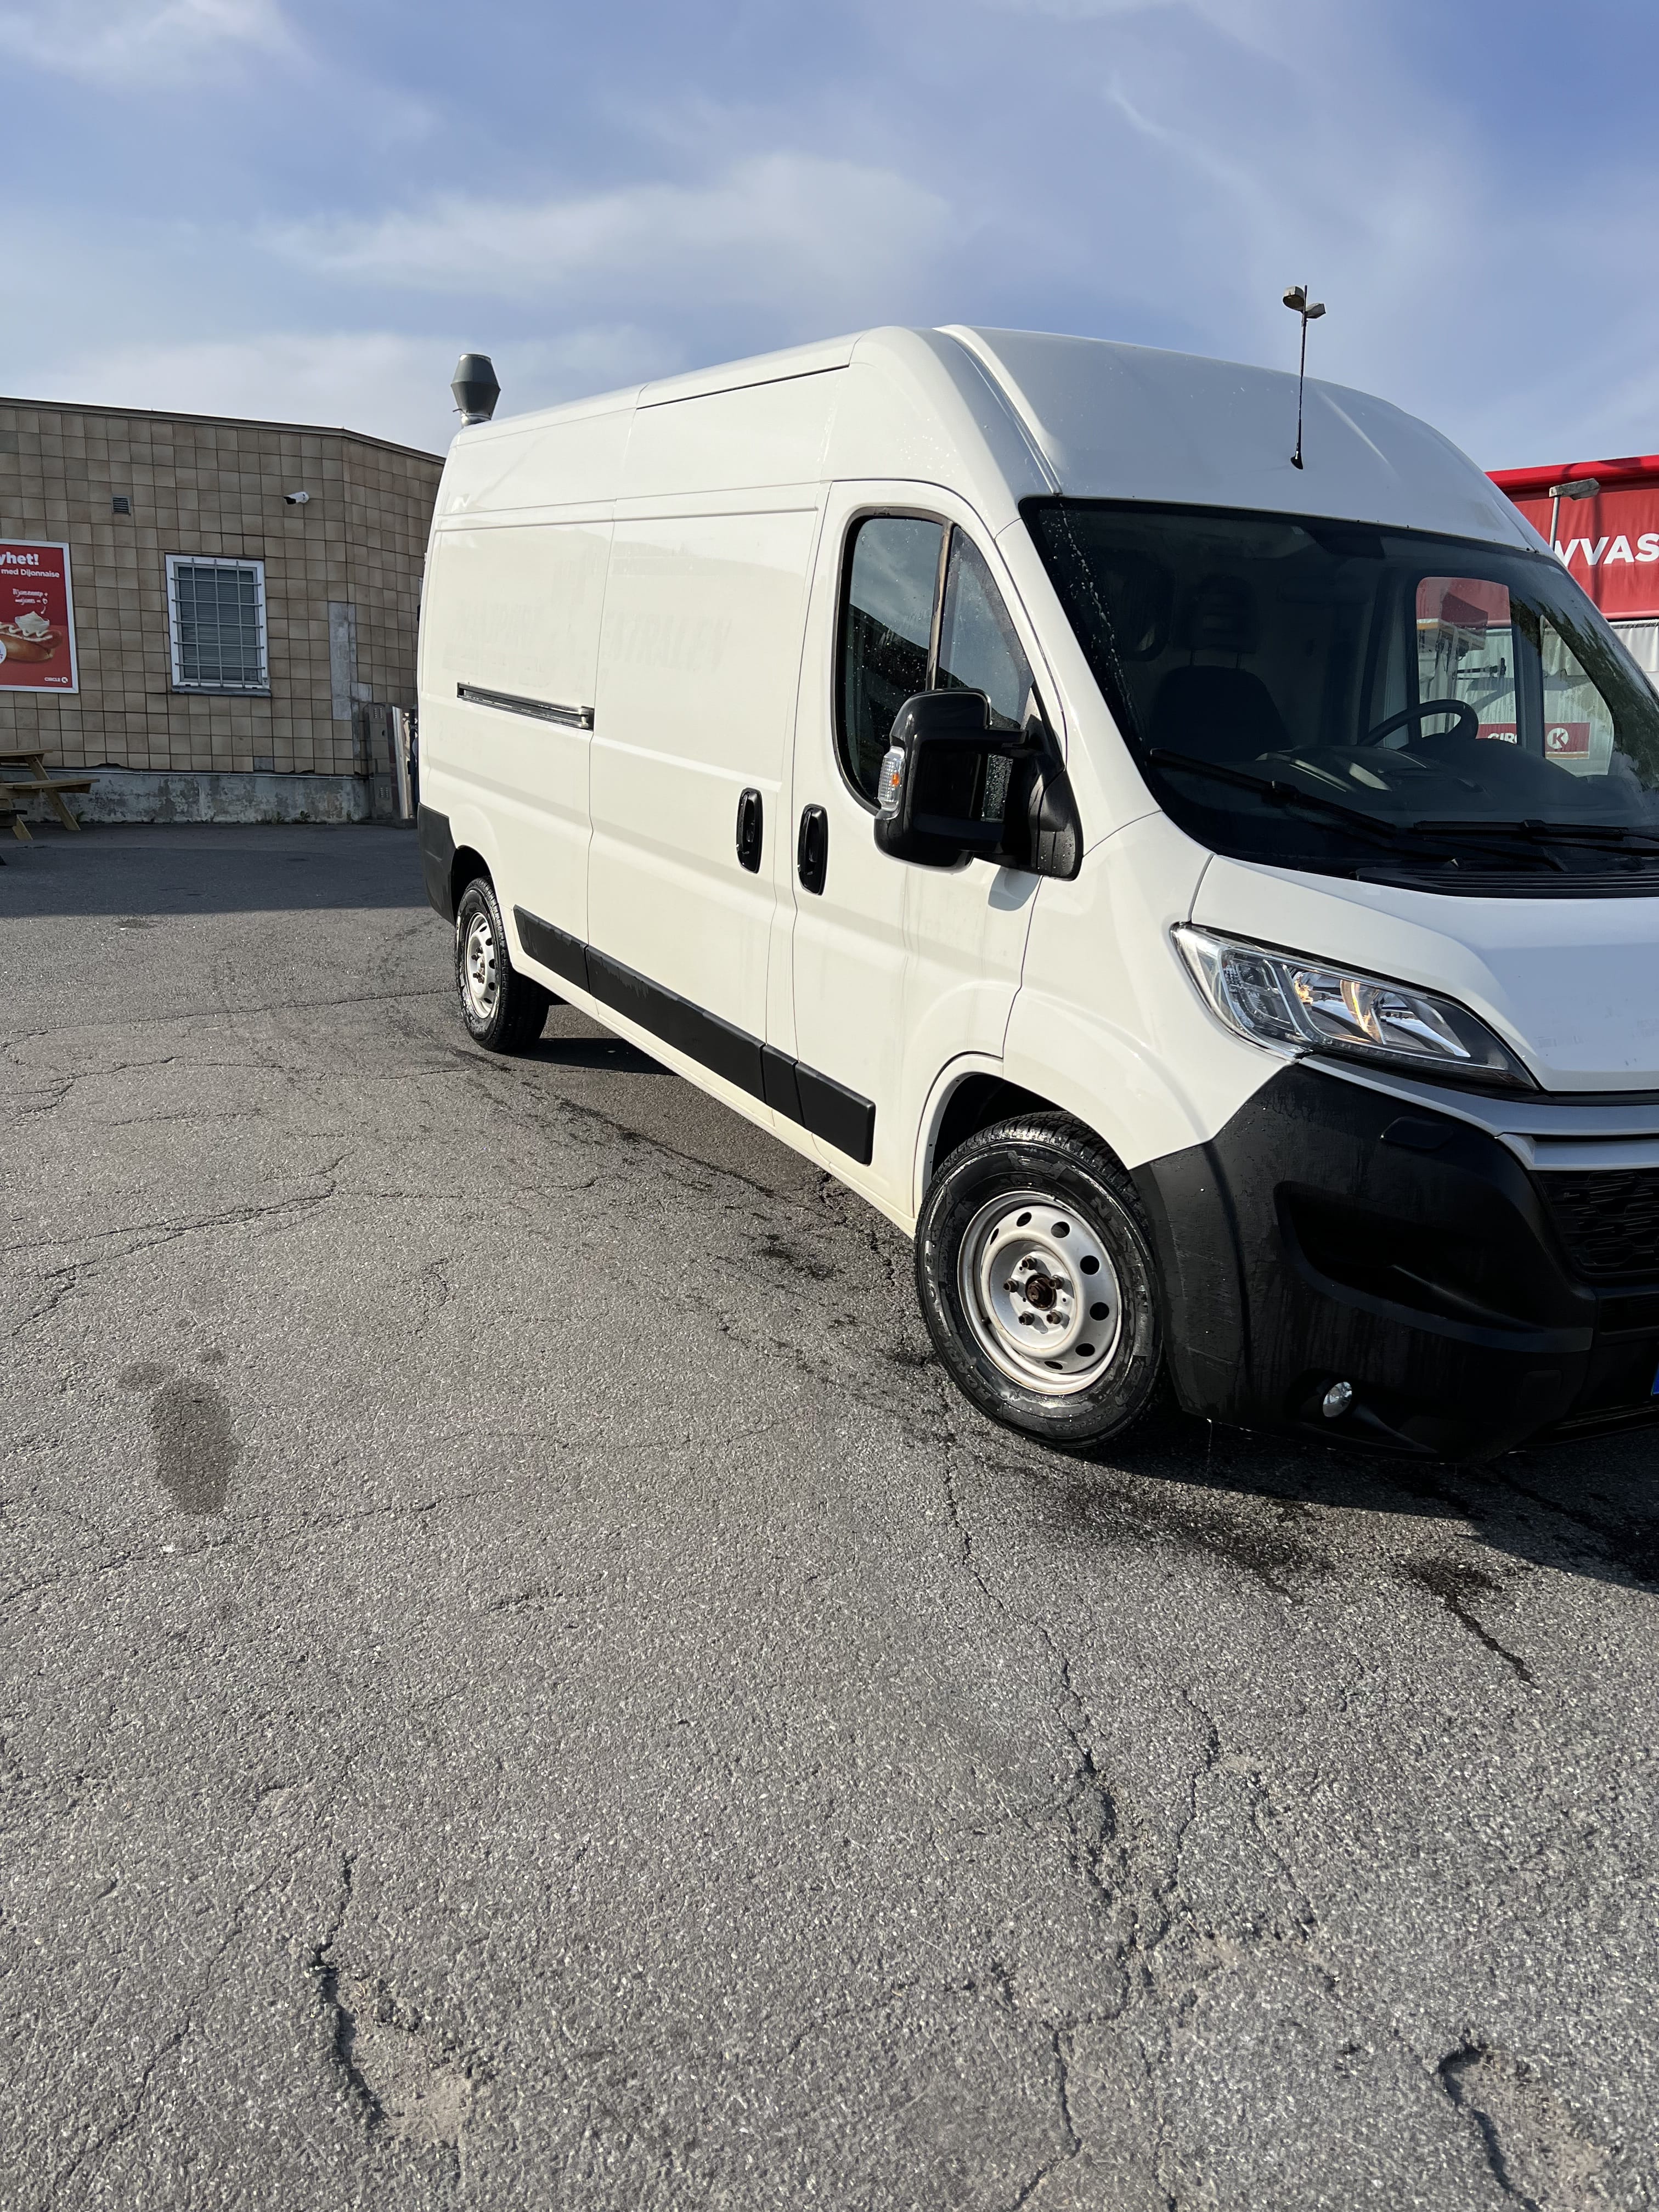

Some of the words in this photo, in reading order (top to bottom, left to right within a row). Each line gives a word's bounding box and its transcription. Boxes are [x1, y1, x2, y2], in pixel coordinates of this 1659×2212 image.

[20, 568, 60, 578] Dijonnaise
[1487, 732, 1517, 744] CIR
[1549, 730, 1568, 749] K
